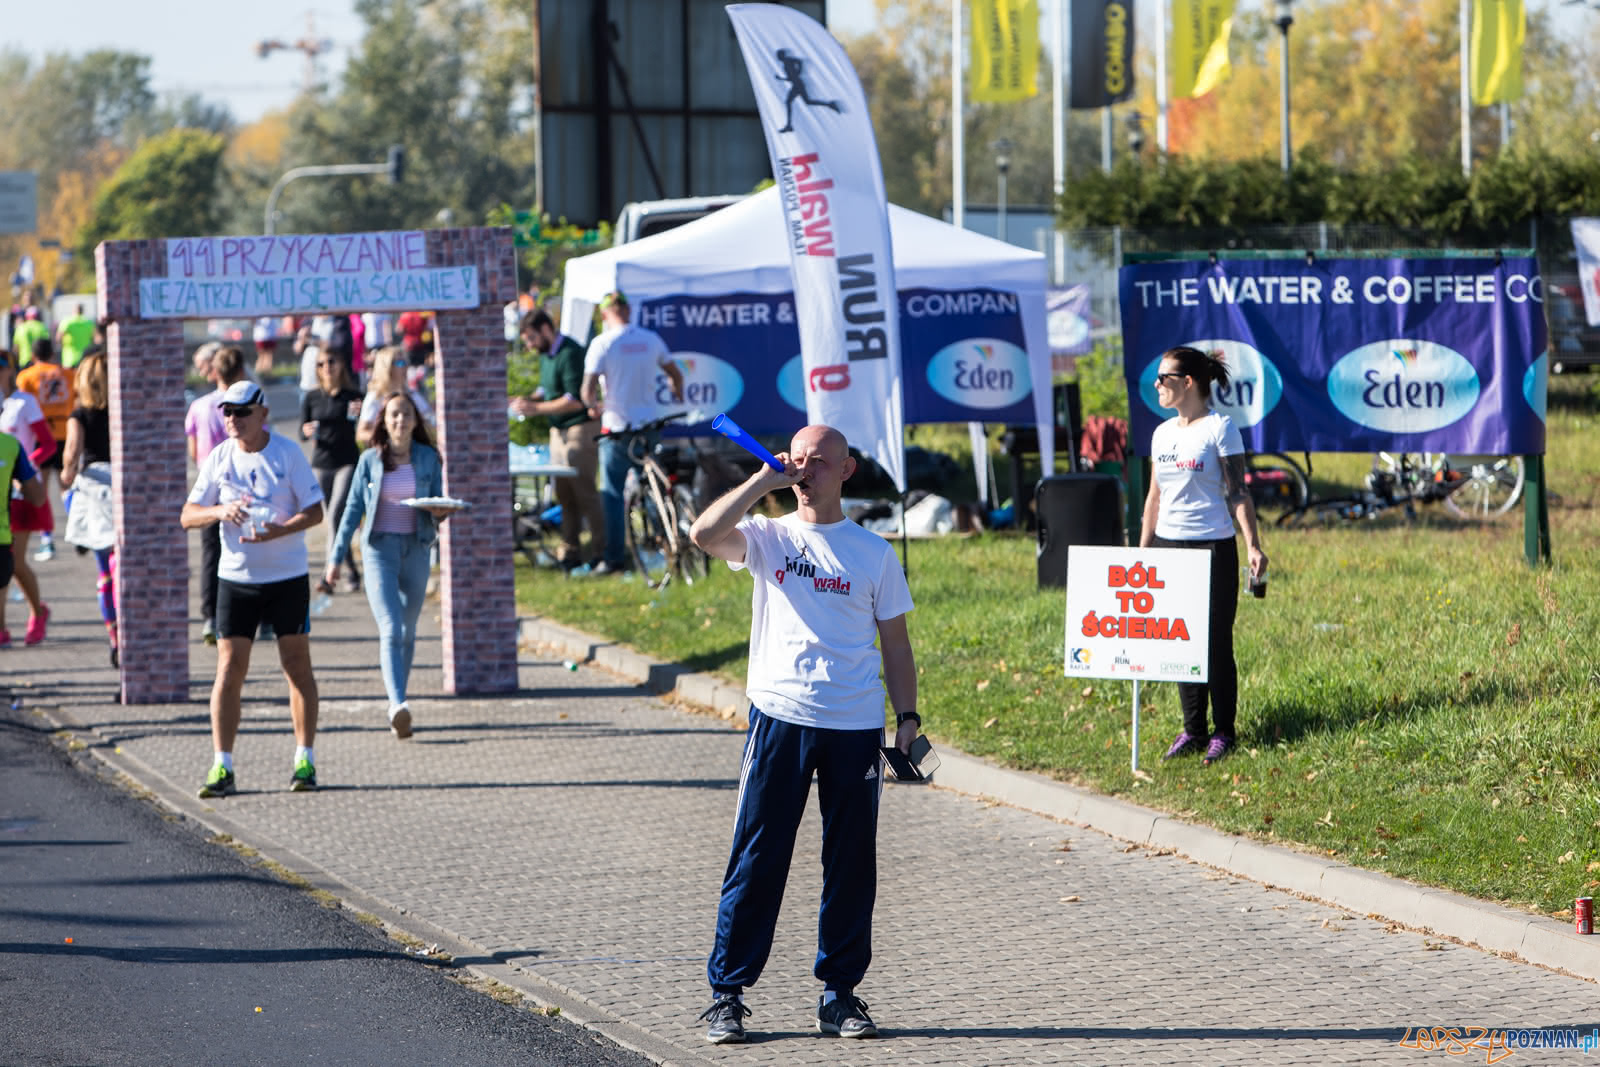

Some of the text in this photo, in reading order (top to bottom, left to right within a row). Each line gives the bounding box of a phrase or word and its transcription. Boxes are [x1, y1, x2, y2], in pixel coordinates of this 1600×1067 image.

[222, 232, 424, 276] PRZYKAZANIE
[906, 293, 1018, 318] COMPAN
[1134, 278, 1200, 308] THE
[1208, 275, 1323, 305] WATER
[1331, 275, 1355, 305] &
[1363, 275, 1496, 305] COFFEE
[642, 302, 794, 328] HE WATER &
[656, 373, 718, 406] Een
[954, 360, 1014, 391] Eden
[1362, 368, 1446, 409] Eden
[1108, 561, 1165, 589] BÓL
[1116, 591, 1155, 614] TO
[1081, 610, 1190, 640] ŚCIEMA
